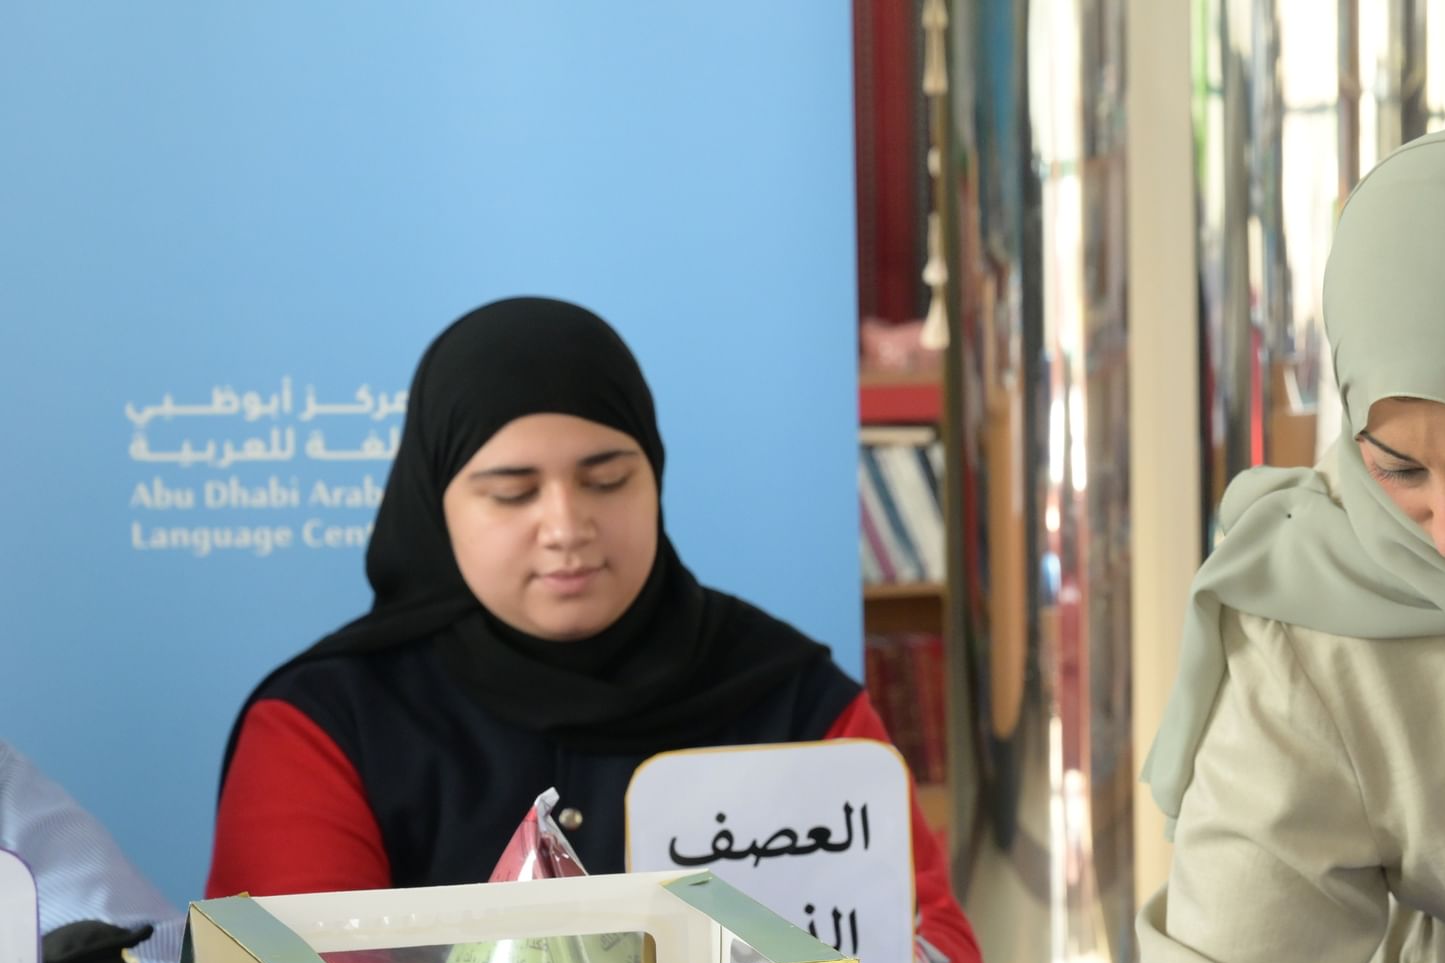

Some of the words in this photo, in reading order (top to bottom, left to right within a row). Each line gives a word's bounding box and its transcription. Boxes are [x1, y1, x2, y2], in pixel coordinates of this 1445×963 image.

[130, 476, 194, 508] Abu
[204, 476, 299, 508] Dhabi
[307, 474, 384, 508] Arab
[131, 520, 293, 557] Language
[669, 801, 871, 868] العصف
